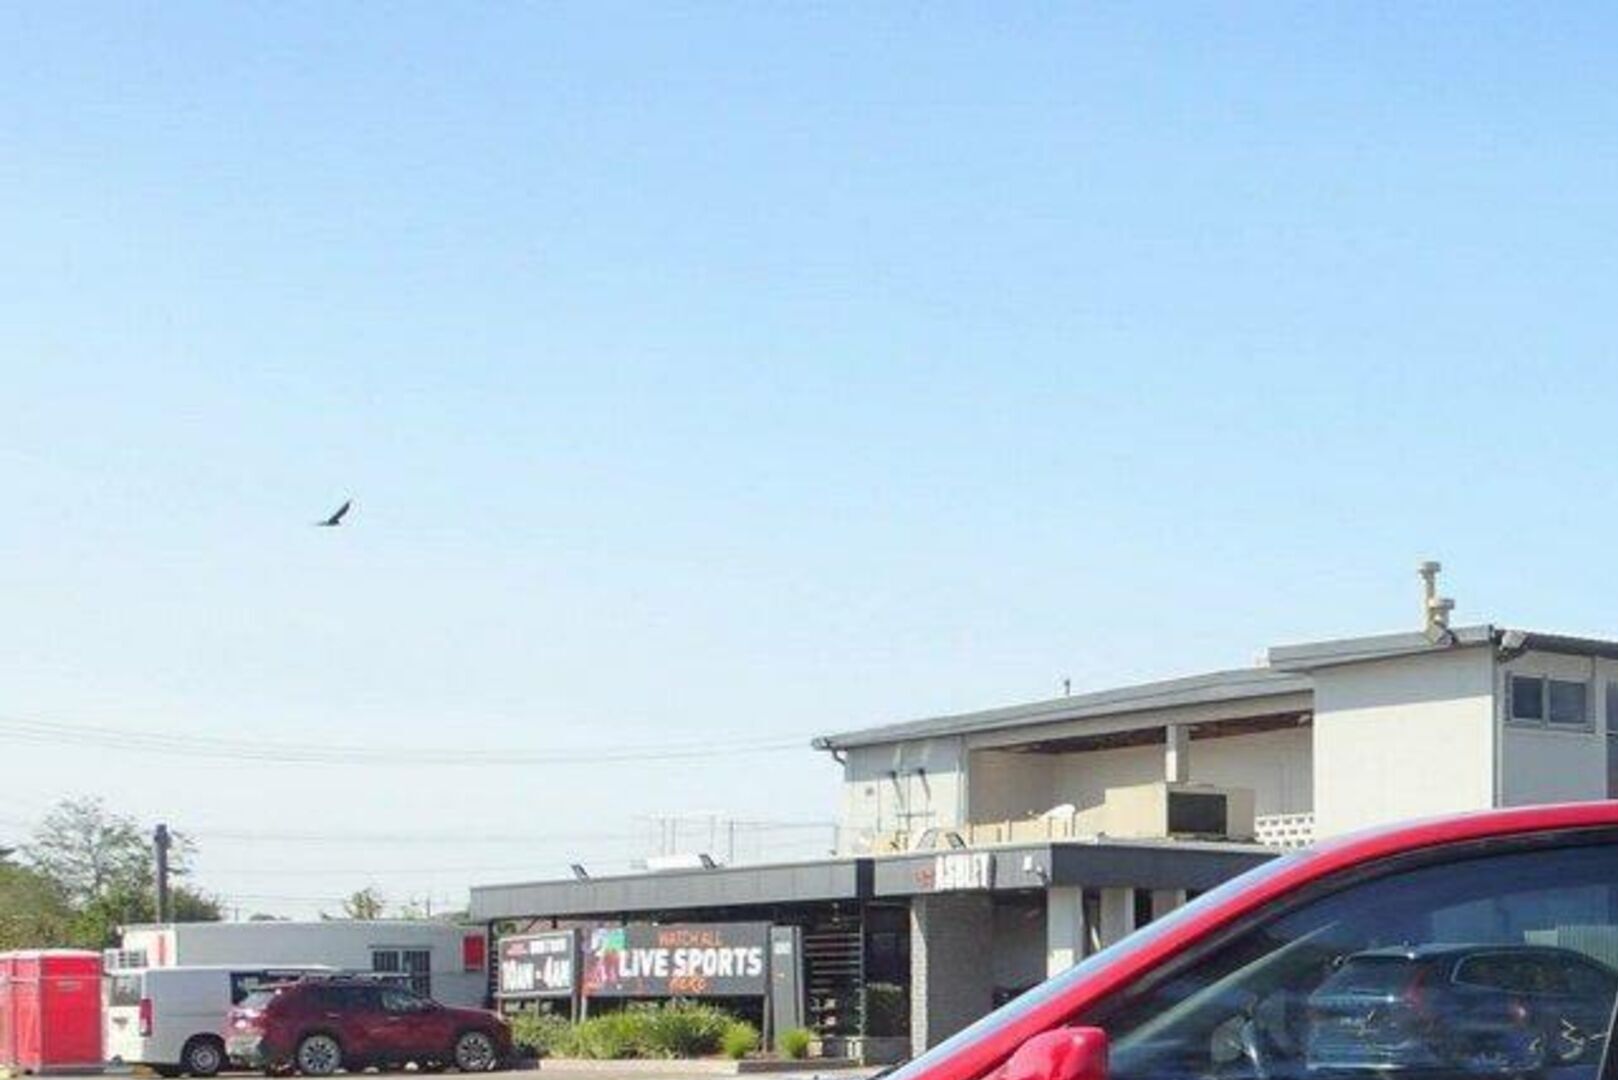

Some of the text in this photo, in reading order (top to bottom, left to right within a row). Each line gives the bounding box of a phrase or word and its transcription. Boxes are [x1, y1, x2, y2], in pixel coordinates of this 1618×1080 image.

[658, 930, 699, 946] WATCH
[618, 946, 763, 977] LIVE SPORTS
